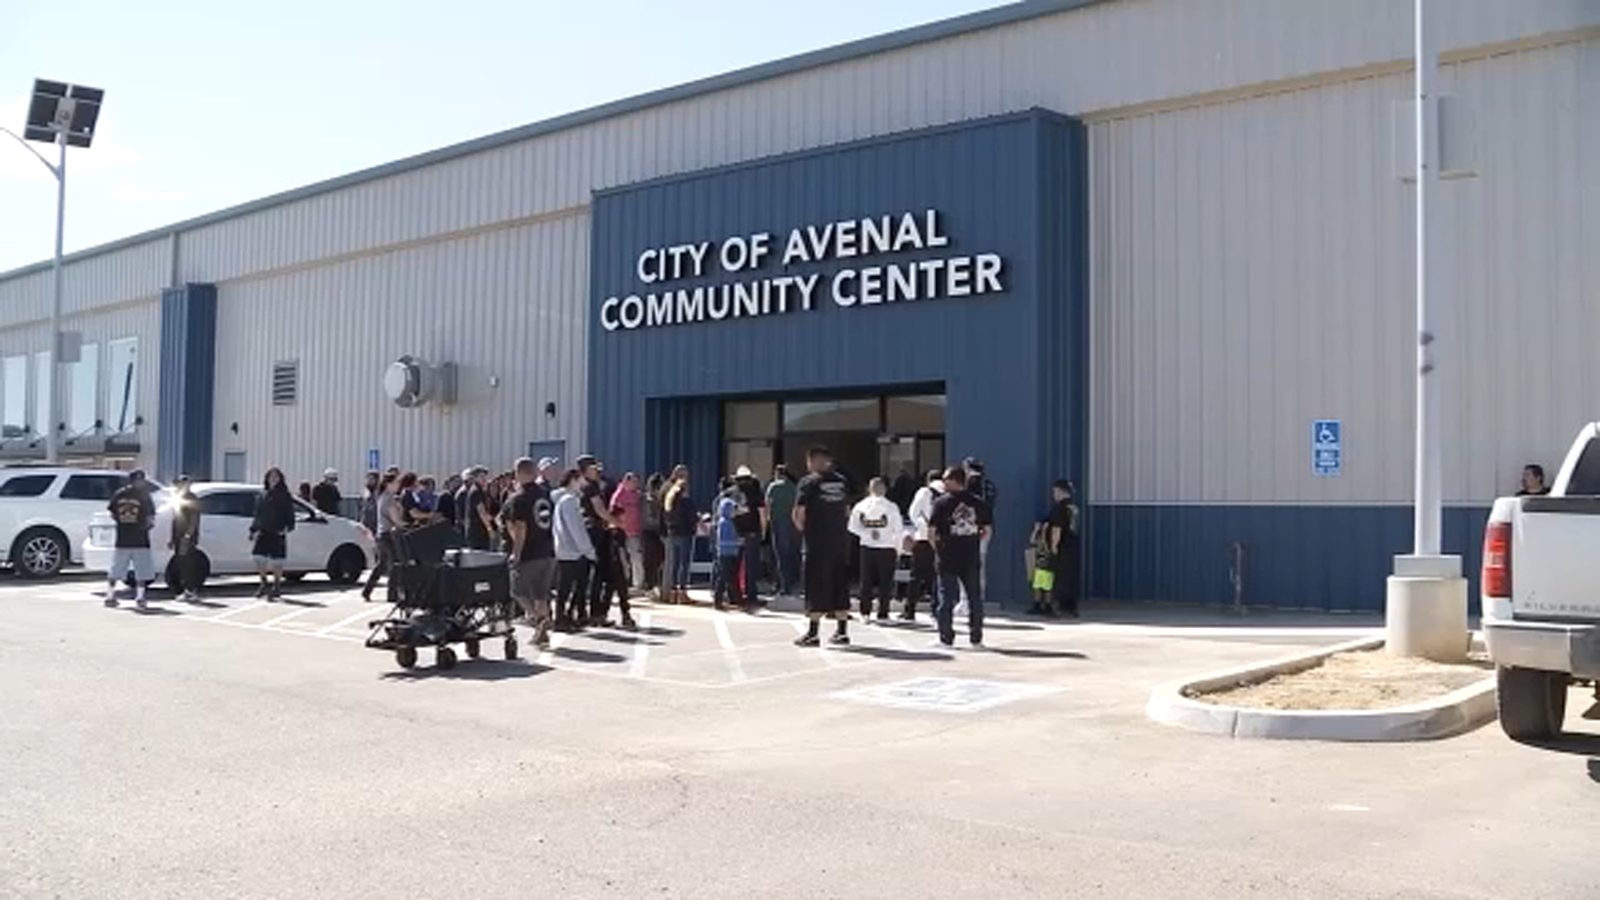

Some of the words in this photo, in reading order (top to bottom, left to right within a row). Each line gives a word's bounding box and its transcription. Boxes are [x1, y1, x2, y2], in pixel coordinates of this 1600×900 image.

[637, 241, 707, 283] CITY
[720, 233, 769, 271] OF
[782, 209, 948, 264] AVENAL
[601, 274, 816, 330] COMMUNITY
[832, 253, 1003, 306] CENTER
